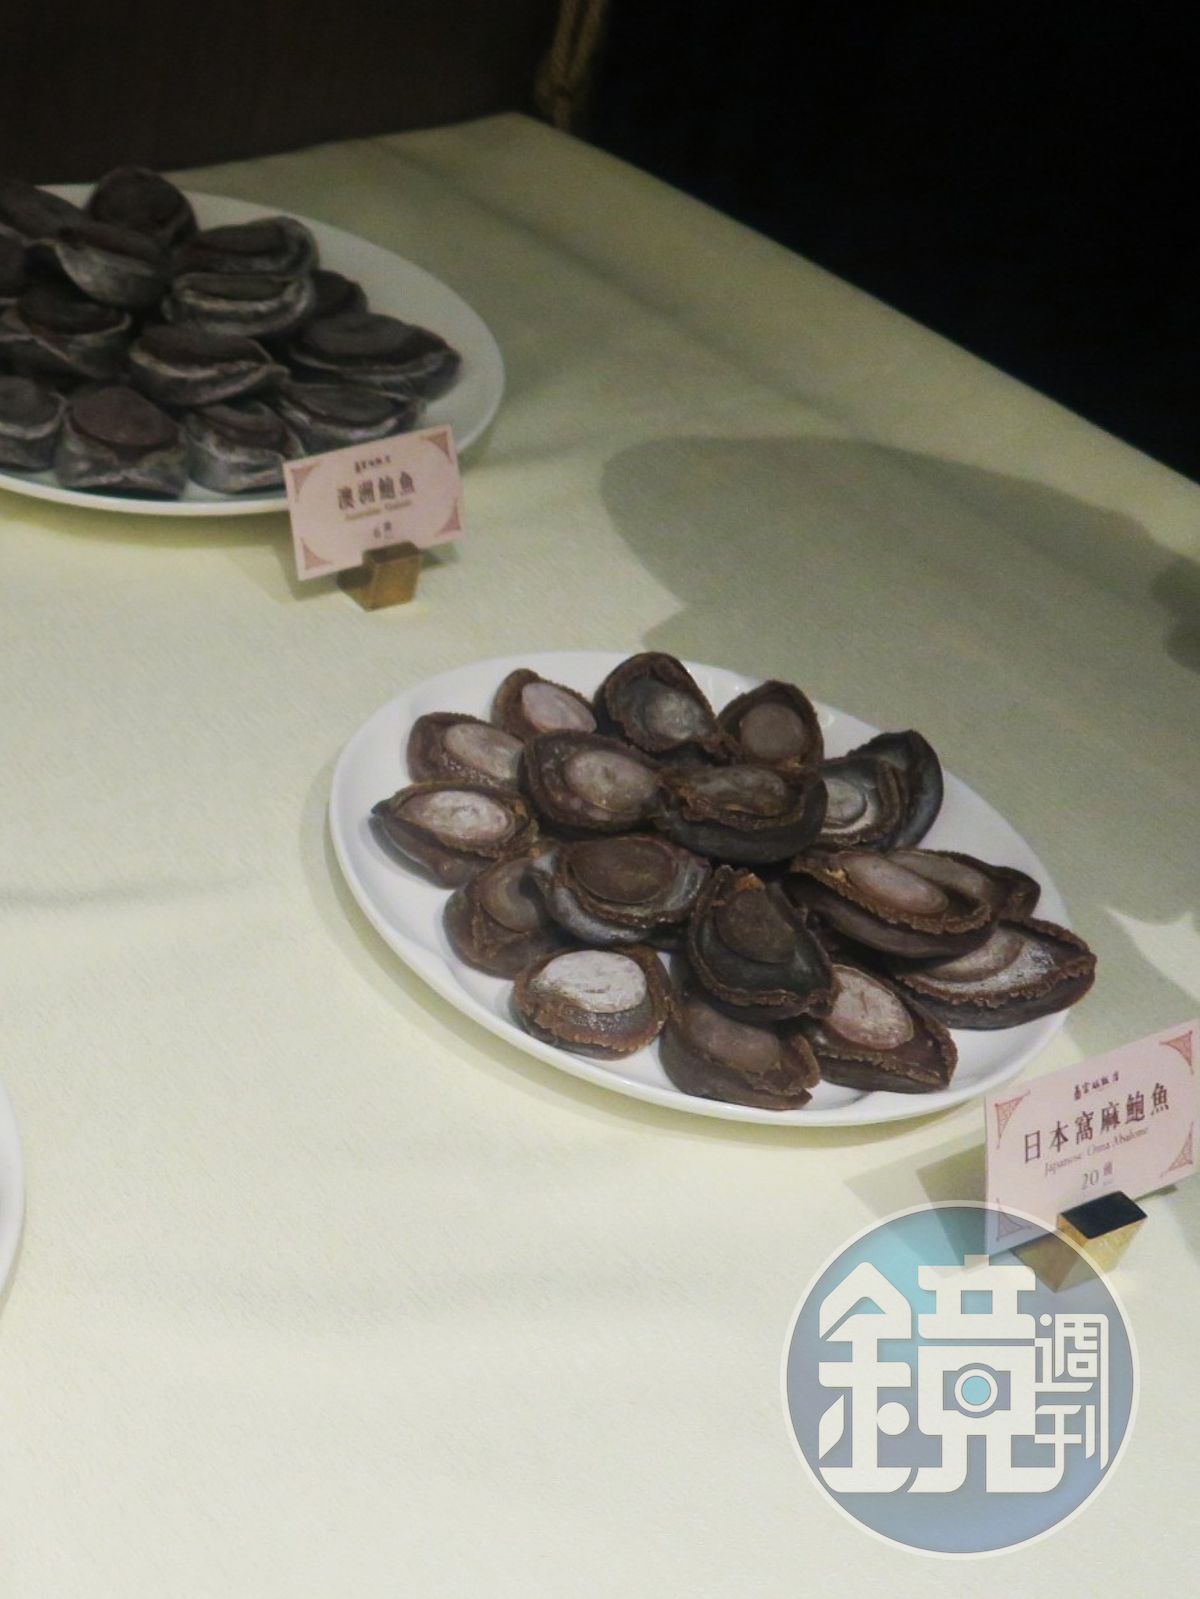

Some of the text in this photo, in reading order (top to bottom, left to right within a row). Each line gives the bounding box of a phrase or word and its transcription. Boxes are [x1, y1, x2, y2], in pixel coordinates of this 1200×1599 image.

[1024, 1082, 1169, 1164] 日本窩麻鮑魚
[1082, 1169, 1100, 1190] 20
